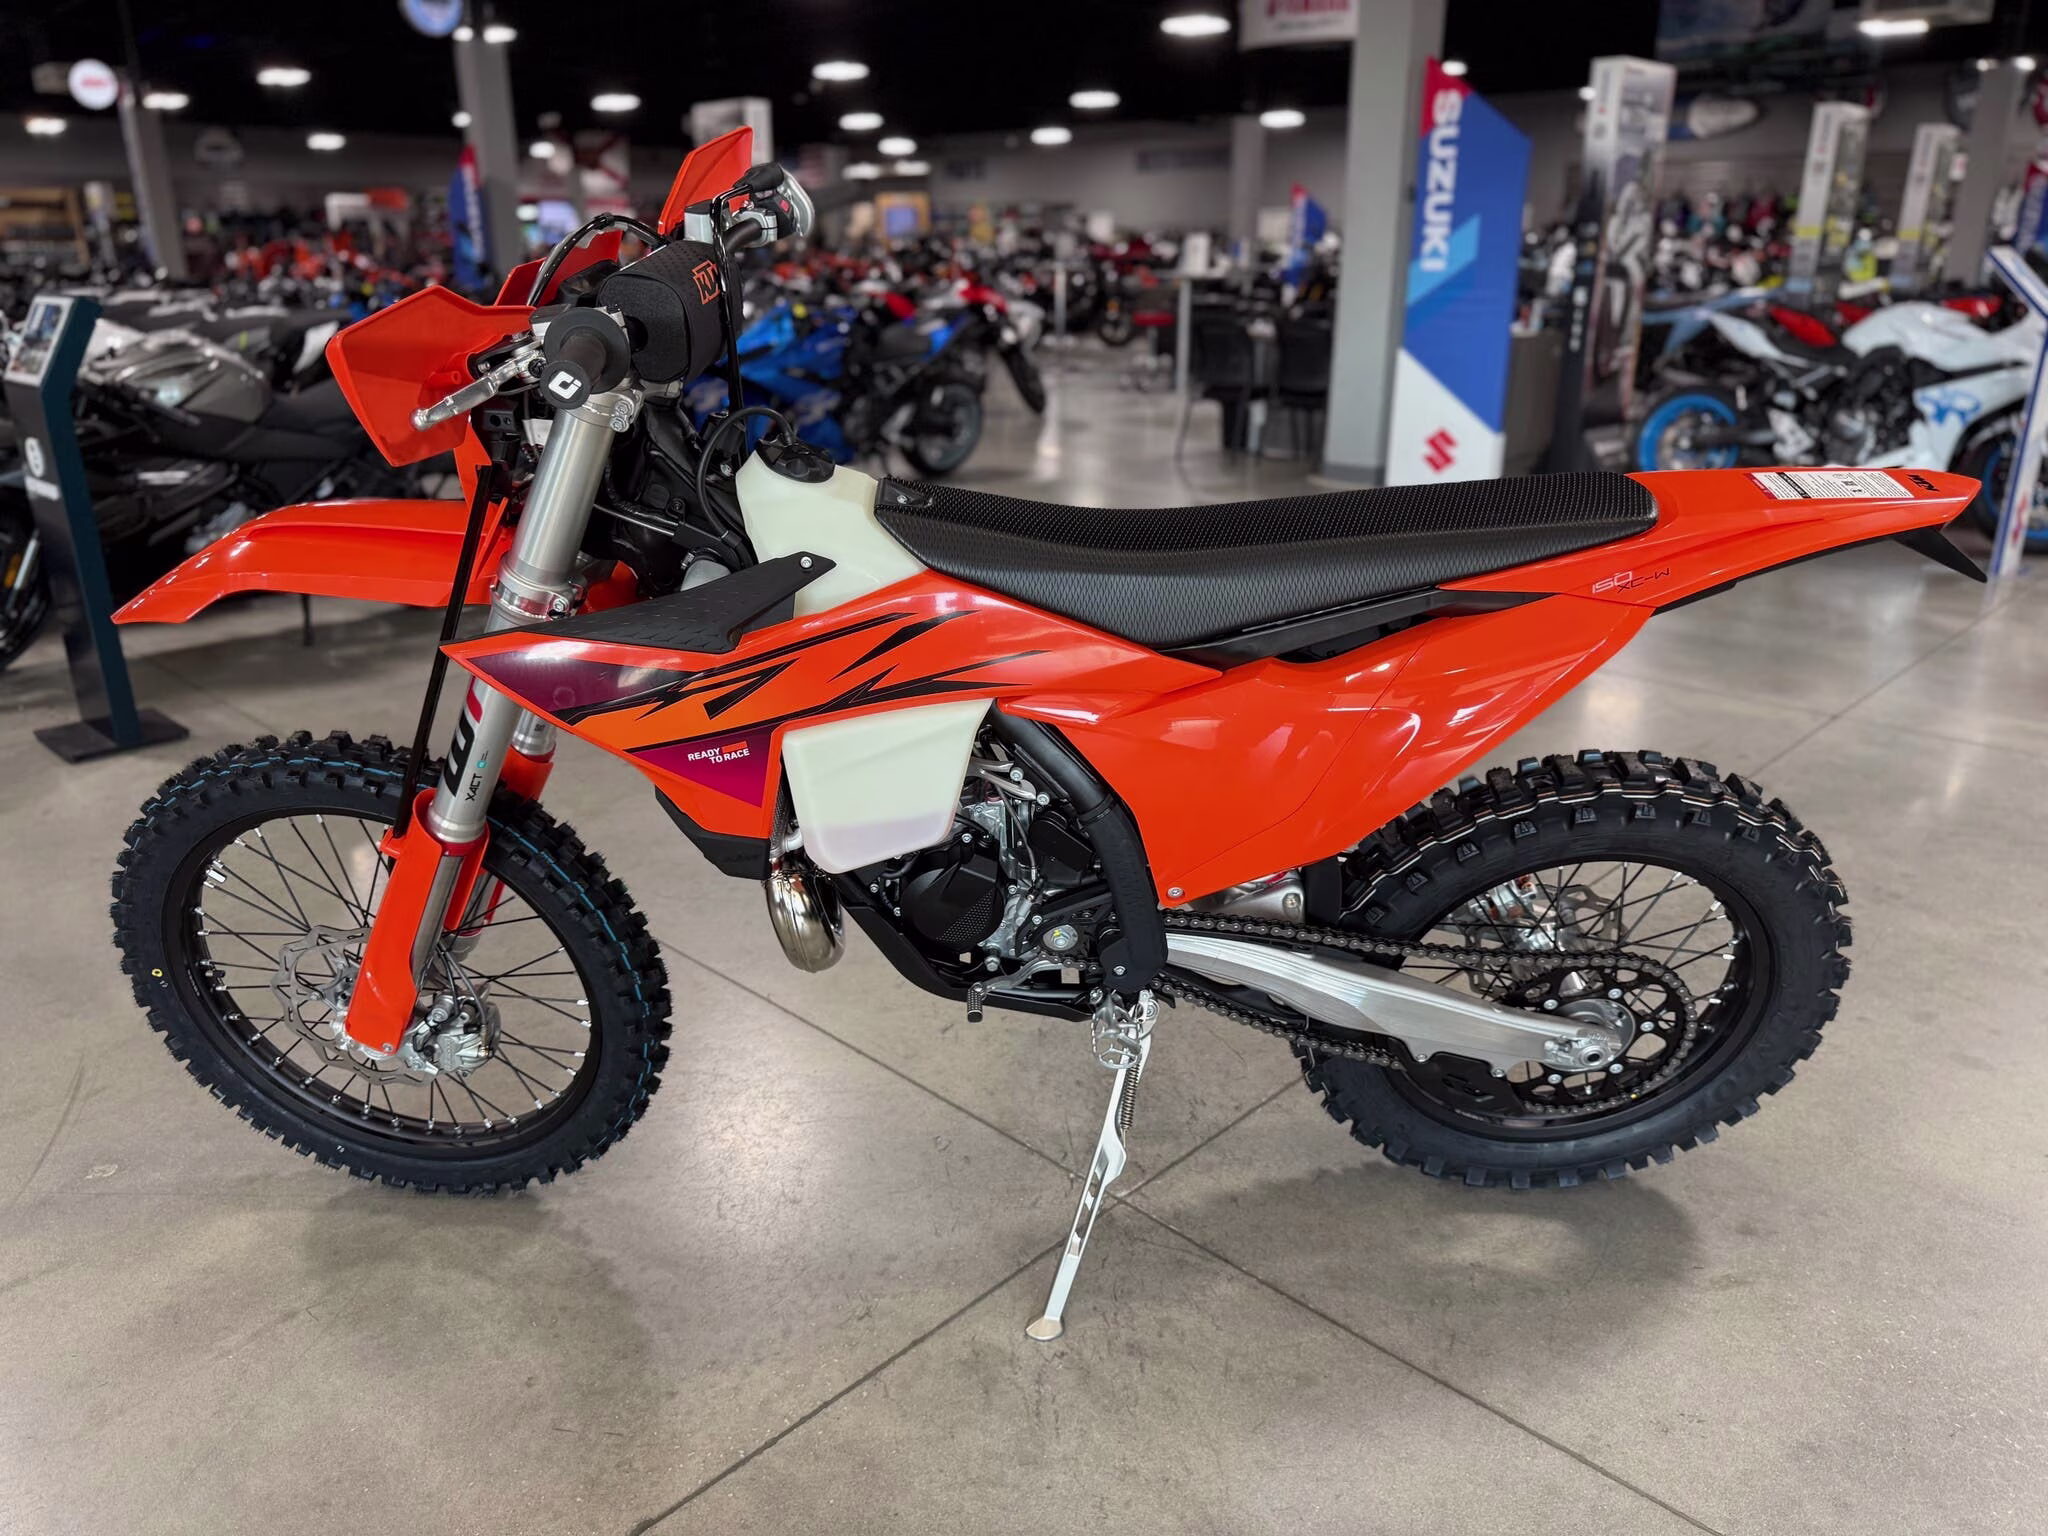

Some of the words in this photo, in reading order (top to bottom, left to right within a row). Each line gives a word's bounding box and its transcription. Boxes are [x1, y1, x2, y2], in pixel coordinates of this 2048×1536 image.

[1419, 88, 1463, 272] SUZUKI
[691, 259, 721, 304] KT
[1592, 571, 1632, 594] 150
[1617, 568, 1670, 594] XC-W
[687, 747, 720, 761] READY
[709, 755, 723, 764] TO
[724, 748, 750, 762] RACE
[464, 773, 484, 802] XACT
